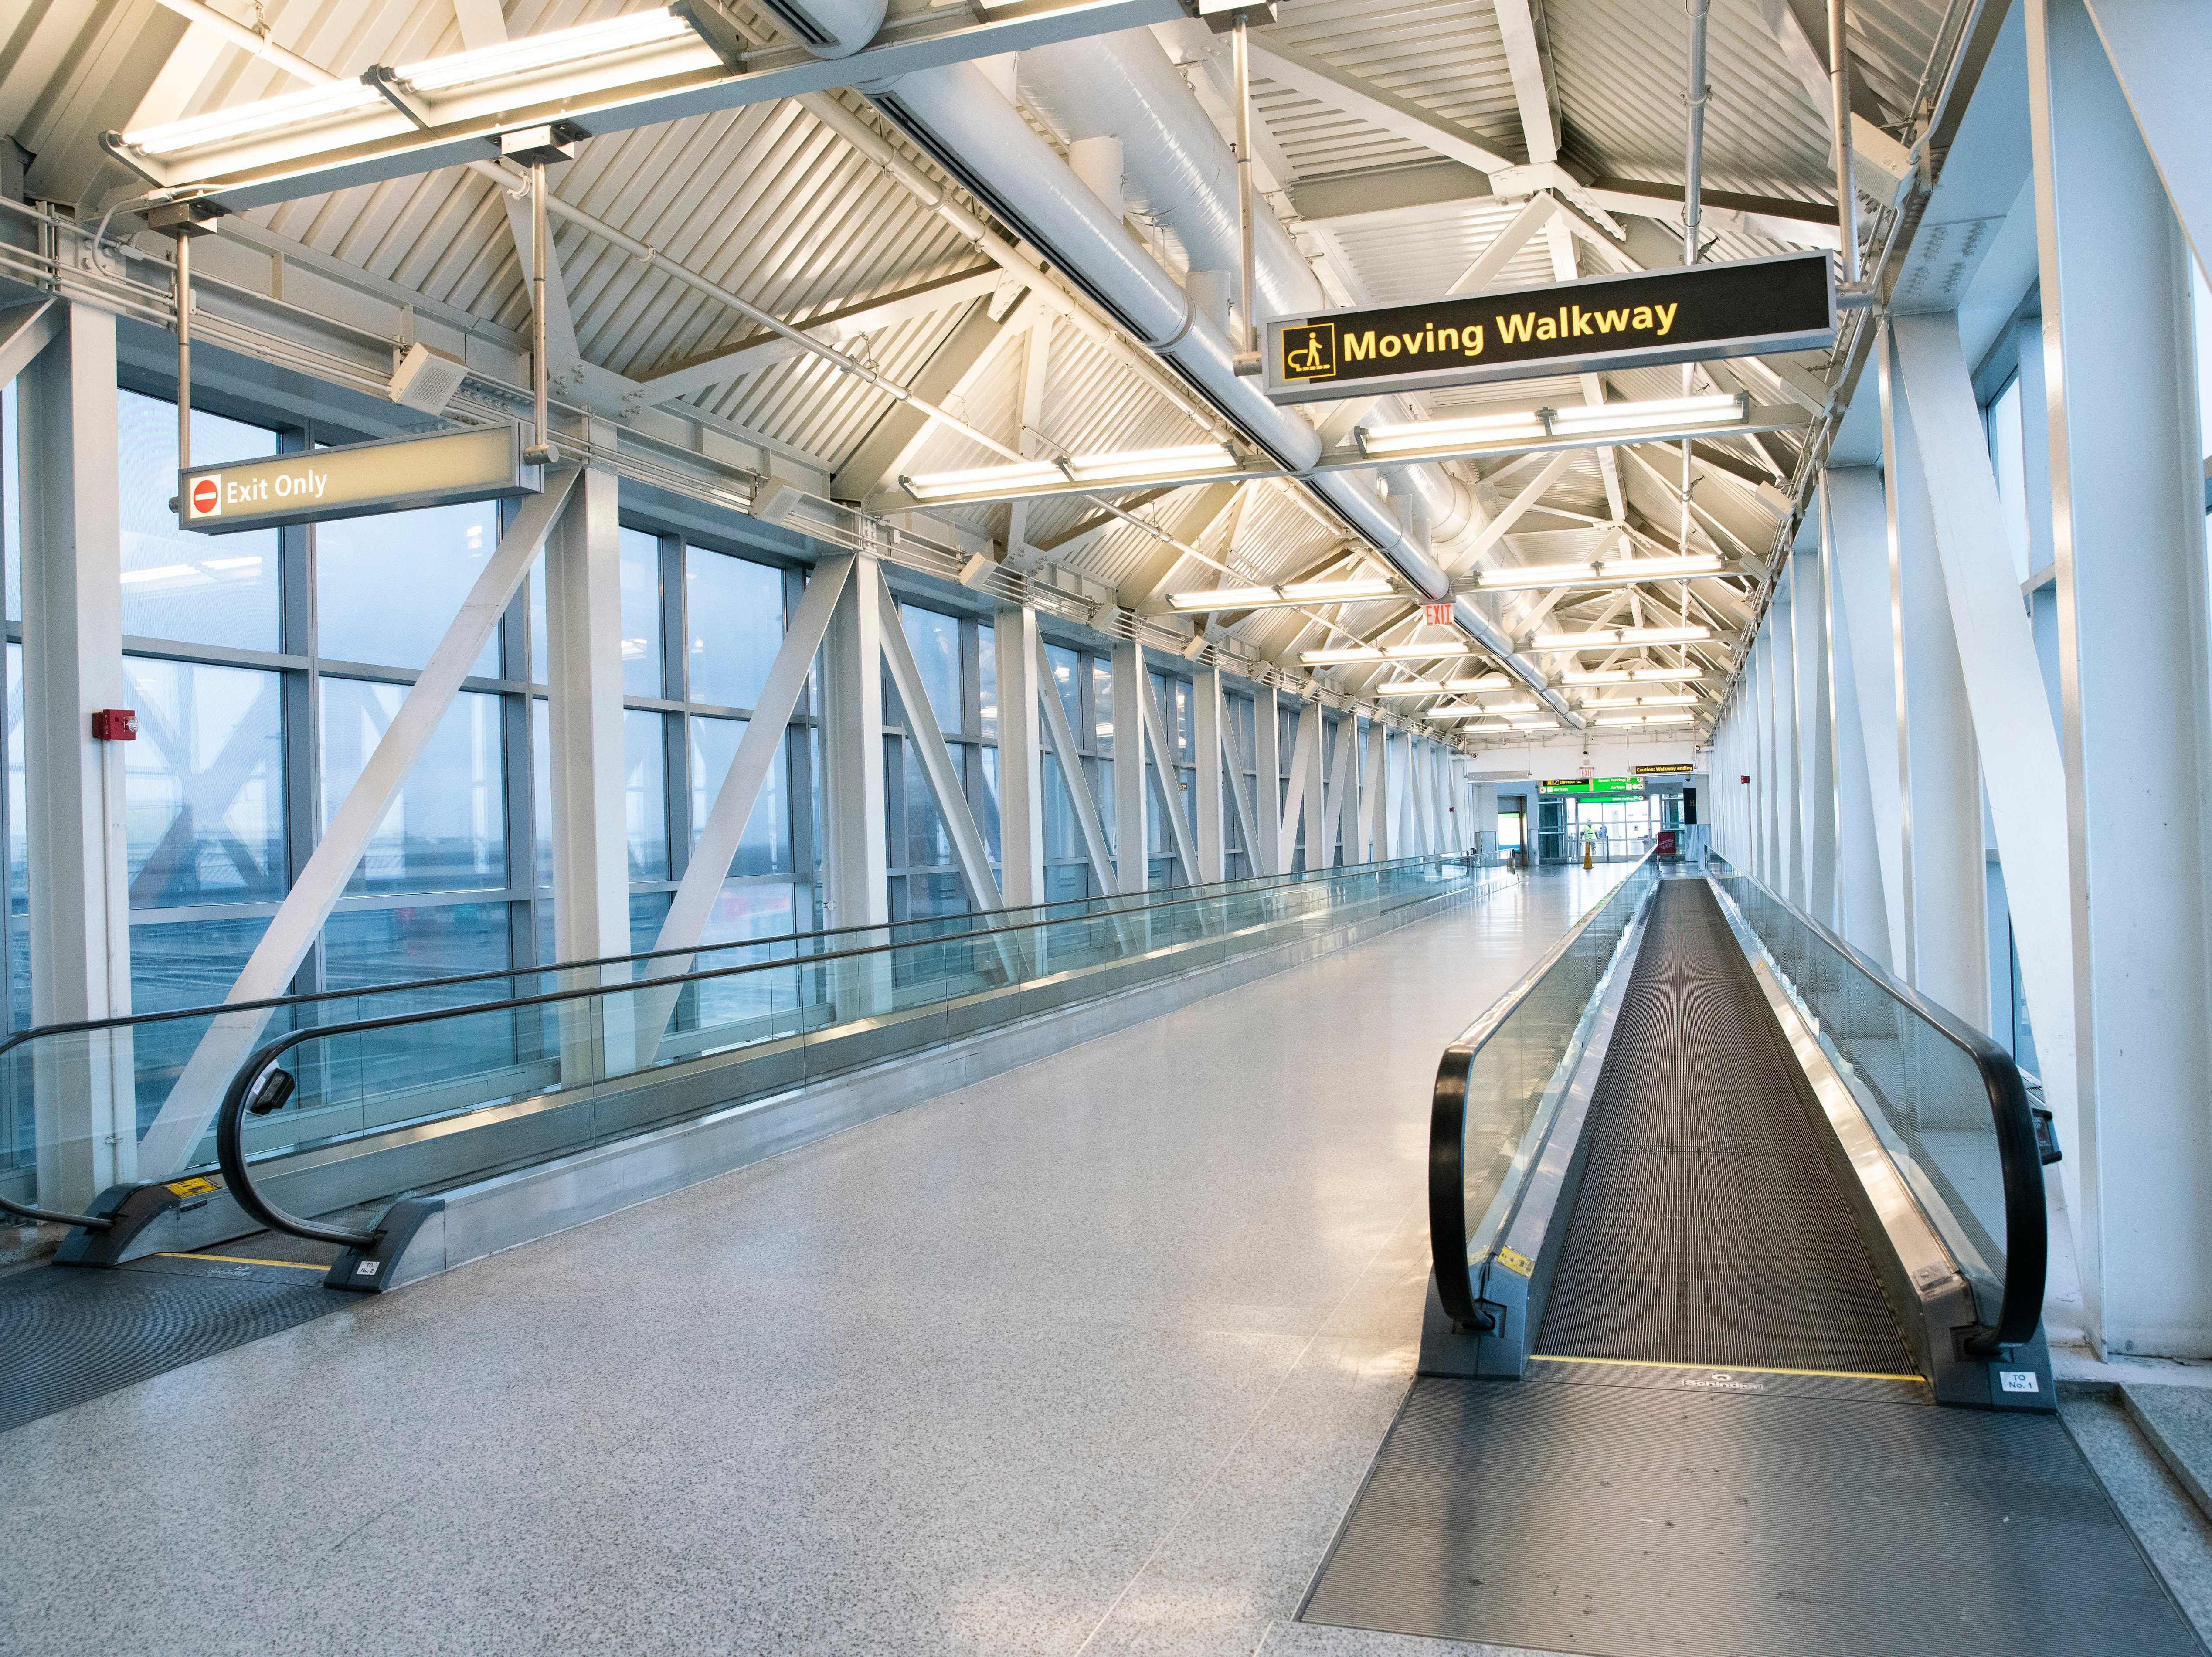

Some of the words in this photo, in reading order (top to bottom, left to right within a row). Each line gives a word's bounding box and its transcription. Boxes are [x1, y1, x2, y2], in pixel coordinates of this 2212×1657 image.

[1344, 323, 1485, 362] Moving
[1496, 303, 1679, 345] Walkway
[227, 477, 268, 504] Exit
[275, 470, 328, 499] Only
[1426, 604, 1452, 625] EXIT
